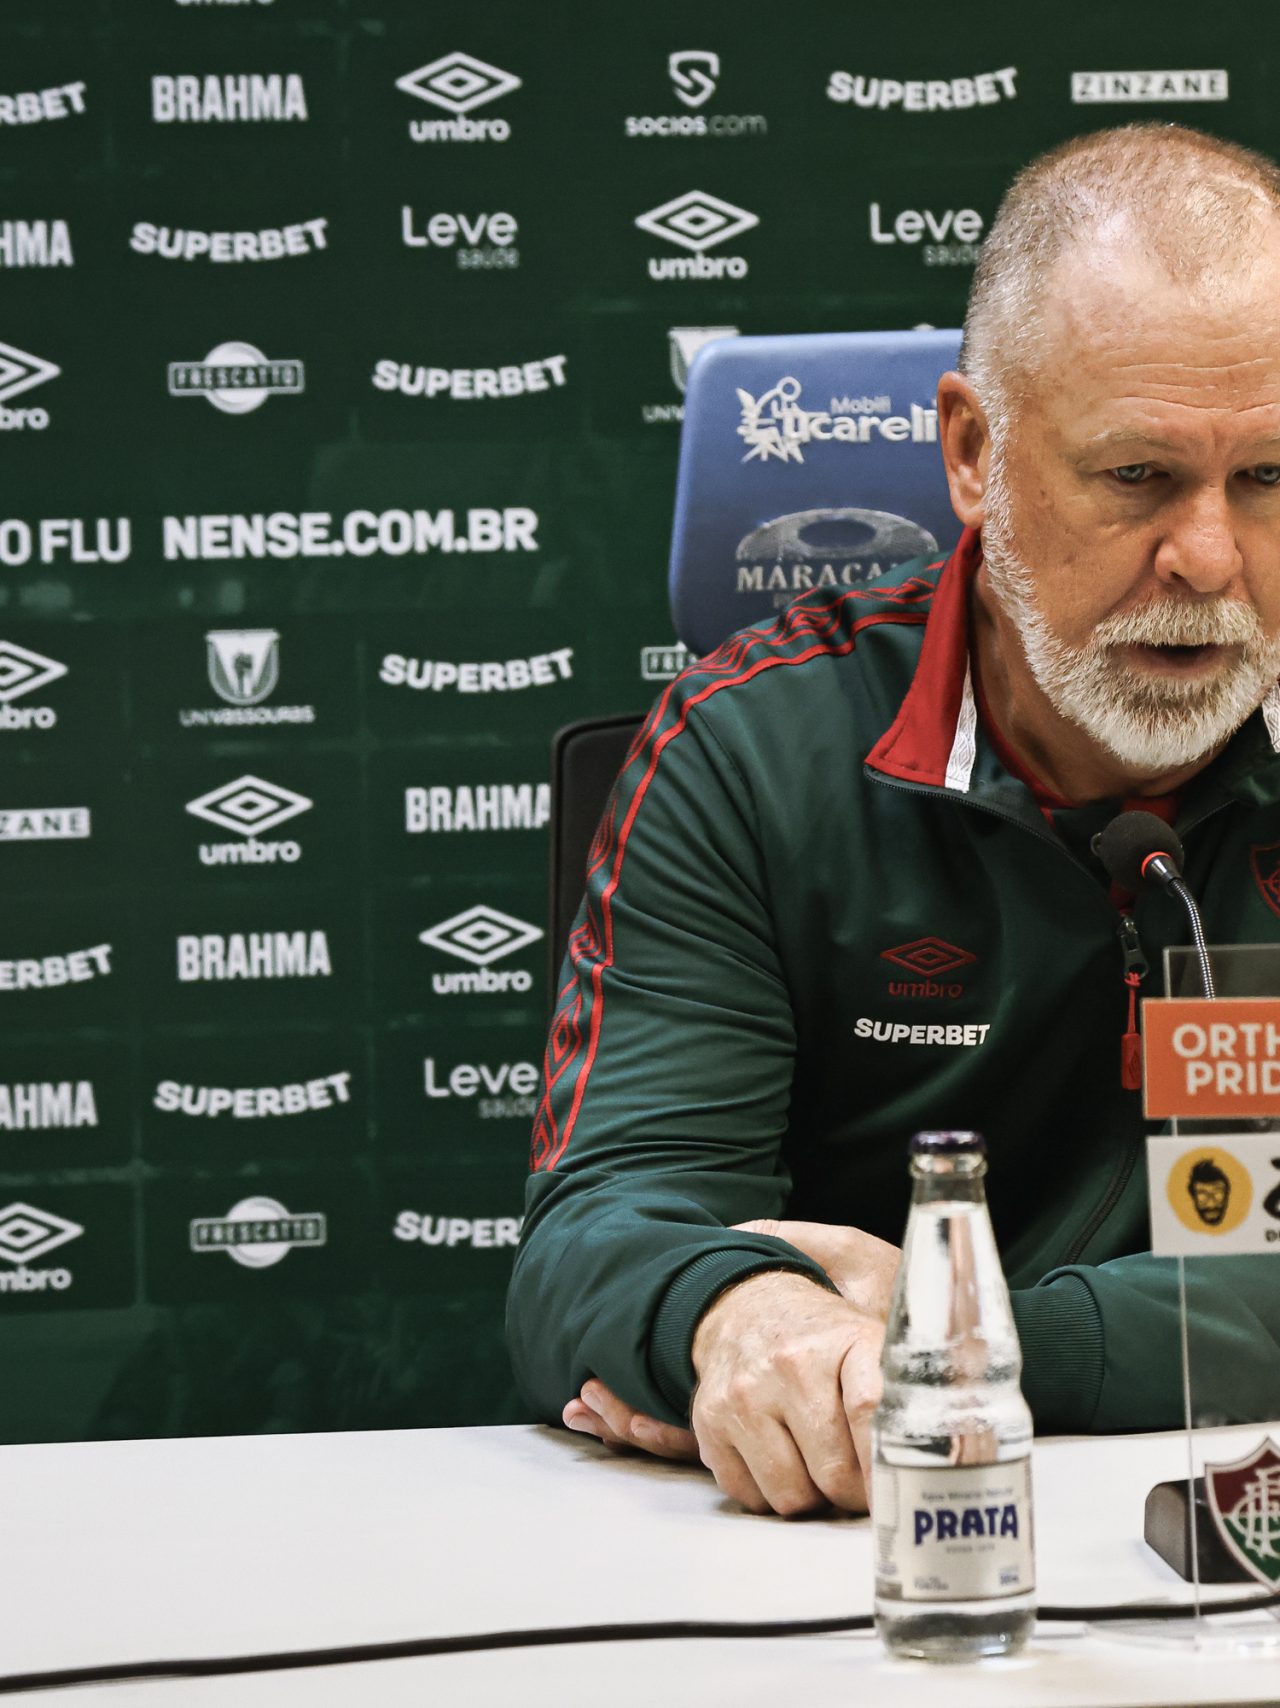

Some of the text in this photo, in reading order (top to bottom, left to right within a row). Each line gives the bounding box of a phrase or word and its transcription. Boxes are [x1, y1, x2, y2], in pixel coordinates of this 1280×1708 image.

[152, 74, 308, 122] BRAHMA
[827, 67, 1017, 111] SUPERBET
[1076, 75, 1223, 99] ZINZANE
[409, 115, 510, 142] umbro
[130, 218, 327, 262] SUPERBET
[402, 206, 518, 246] Leve
[870, 203, 983, 243] Leve
[648, 254, 748, 280] umbro
[372, 355, 566, 399] SUPERBET
[40, 518, 131, 563] FLU
[163, 507, 538, 560] NENSE.COM.BR
[735, 562, 898, 593] MARACA
[379, 648, 573, 693] SUPERBET
[199, 838, 301, 865] umbro
[177, 931, 331, 981] BRAHMA
[432, 967, 532, 994] umbro
[888, 980, 963, 998] umbro
[853, 1016, 992, 1047] SUPERBET
[154, 1072, 350, 1118] SUPERBET
[424, 1058, 539, 1097] Leve
[393, 1210, 526, 1248] SUPER
[913, 1502, 1019, 1546] PRATA
